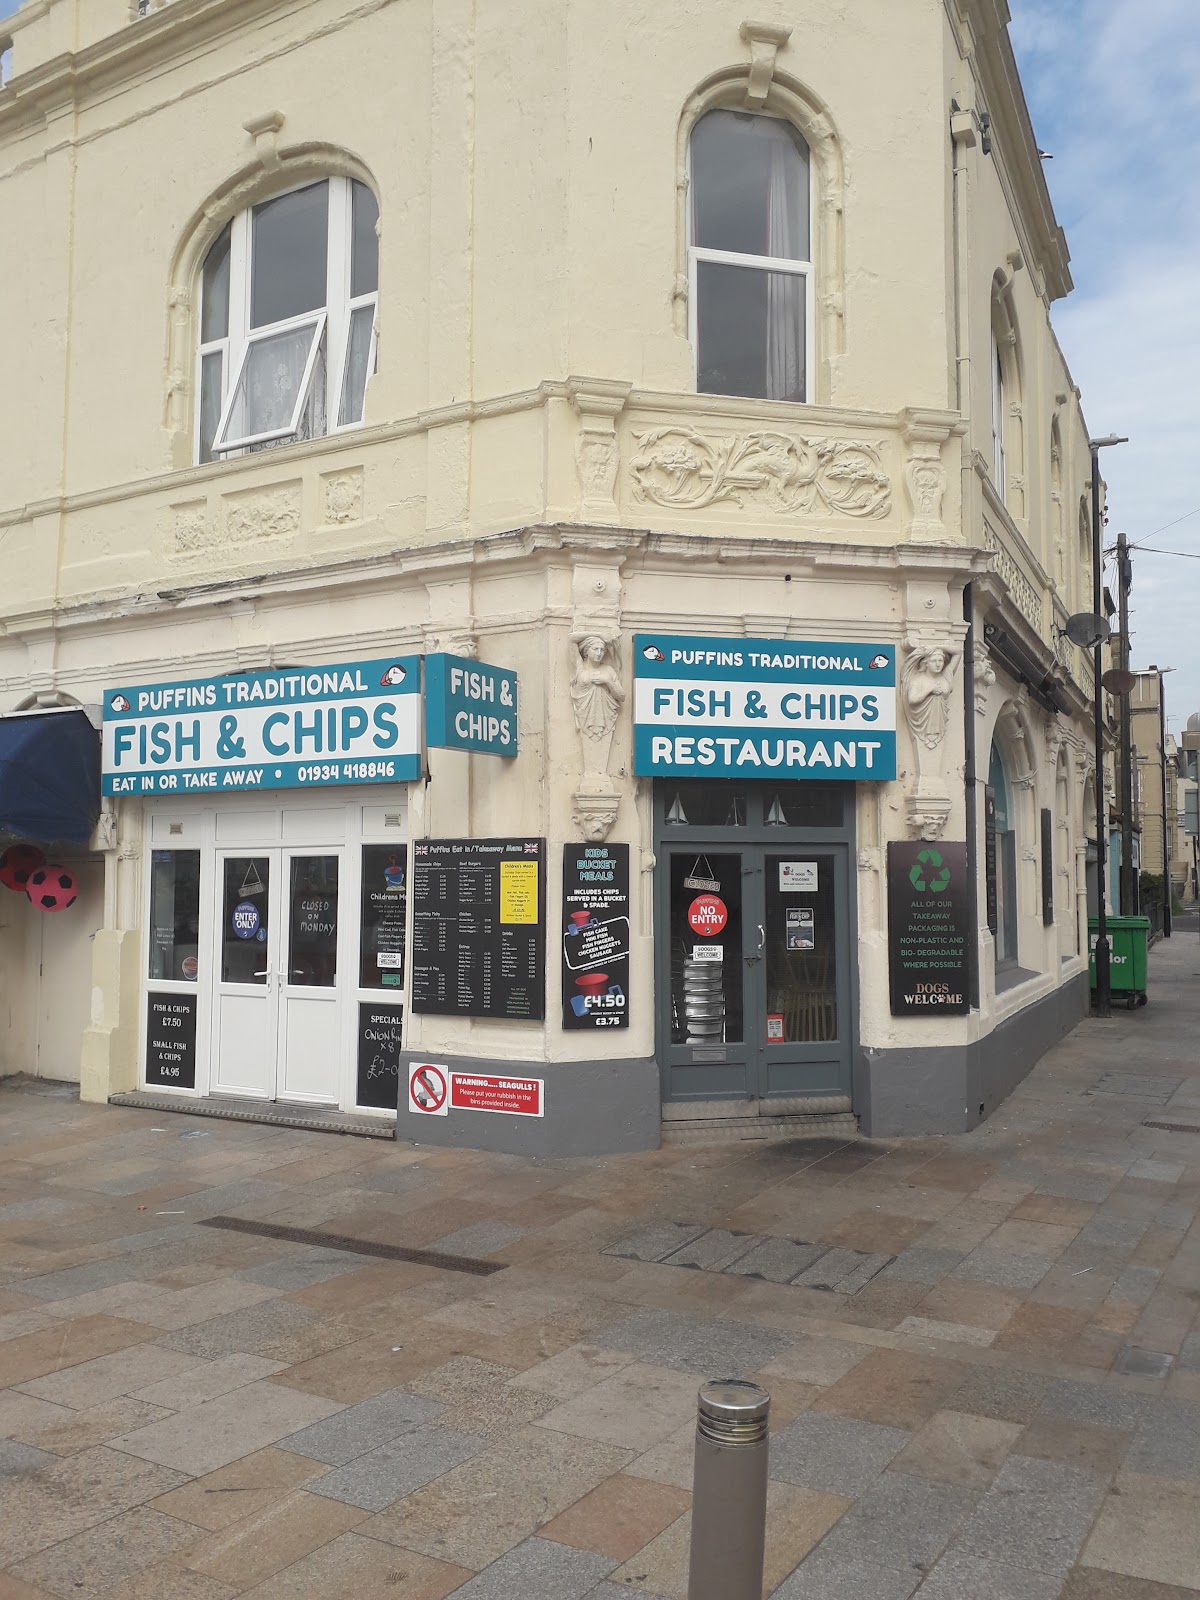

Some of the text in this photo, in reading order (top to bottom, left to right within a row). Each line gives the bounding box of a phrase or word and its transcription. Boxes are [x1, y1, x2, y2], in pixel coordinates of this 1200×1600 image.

[671, 649, 863, 671] PUFFINS TRADITIONAL
[138, 670, 369, 712] PUFFINS TRADITIONAL
[451, 667, 514, 707] FISH &
[653, 688, 879, 722] FISH & CHIPS
[455, 711, 511, 745] CHIPS
[114, 702, 399, 767] FISH & CHIPS
[651, 736, 882, 769] RESTAURANT
[112, 762, 395, 792] EAT IN OR TAKE AWAY 01934 418846
[585, 848, 609, 858] KIDS
[577, 859, 617, 870] BUCKET
[579, 871, 614, 881] MEALS
[302, 901, 329, 911] CLOSED
[700, 906, 716, 915] NO
[235, 912, 257, 921] ENTER
[691, 914, 724, 924] ENTRY
[236, 920, 255, 929] ONLY
[300, 921, 335, 936] MONDAY
[589, 949, 612, 959] SAUSAGE
[916, 983, 949, 994] DOGS
[584, 994, 625, 1008] £4.50
[153, 1004, 190, 1014] FISH & CHIPS
[162, 1017, 182, 1028] £7.50
[595, 1017, 620, 1026] £3.75
[152, 1040, 187, 1050] SMALL FISH
[388, 1042, 395, 1053] 8
[158, 1052, 182, 1061] & CHIPS
[160, 1066, 180, 1077] £4.95
[459, 1088, 475, 1096] Please
[475, 1090, 484, 1098] put
[497, 1092, 516, 1100] rubbish
[481, 1099, 504, 1107] provided
